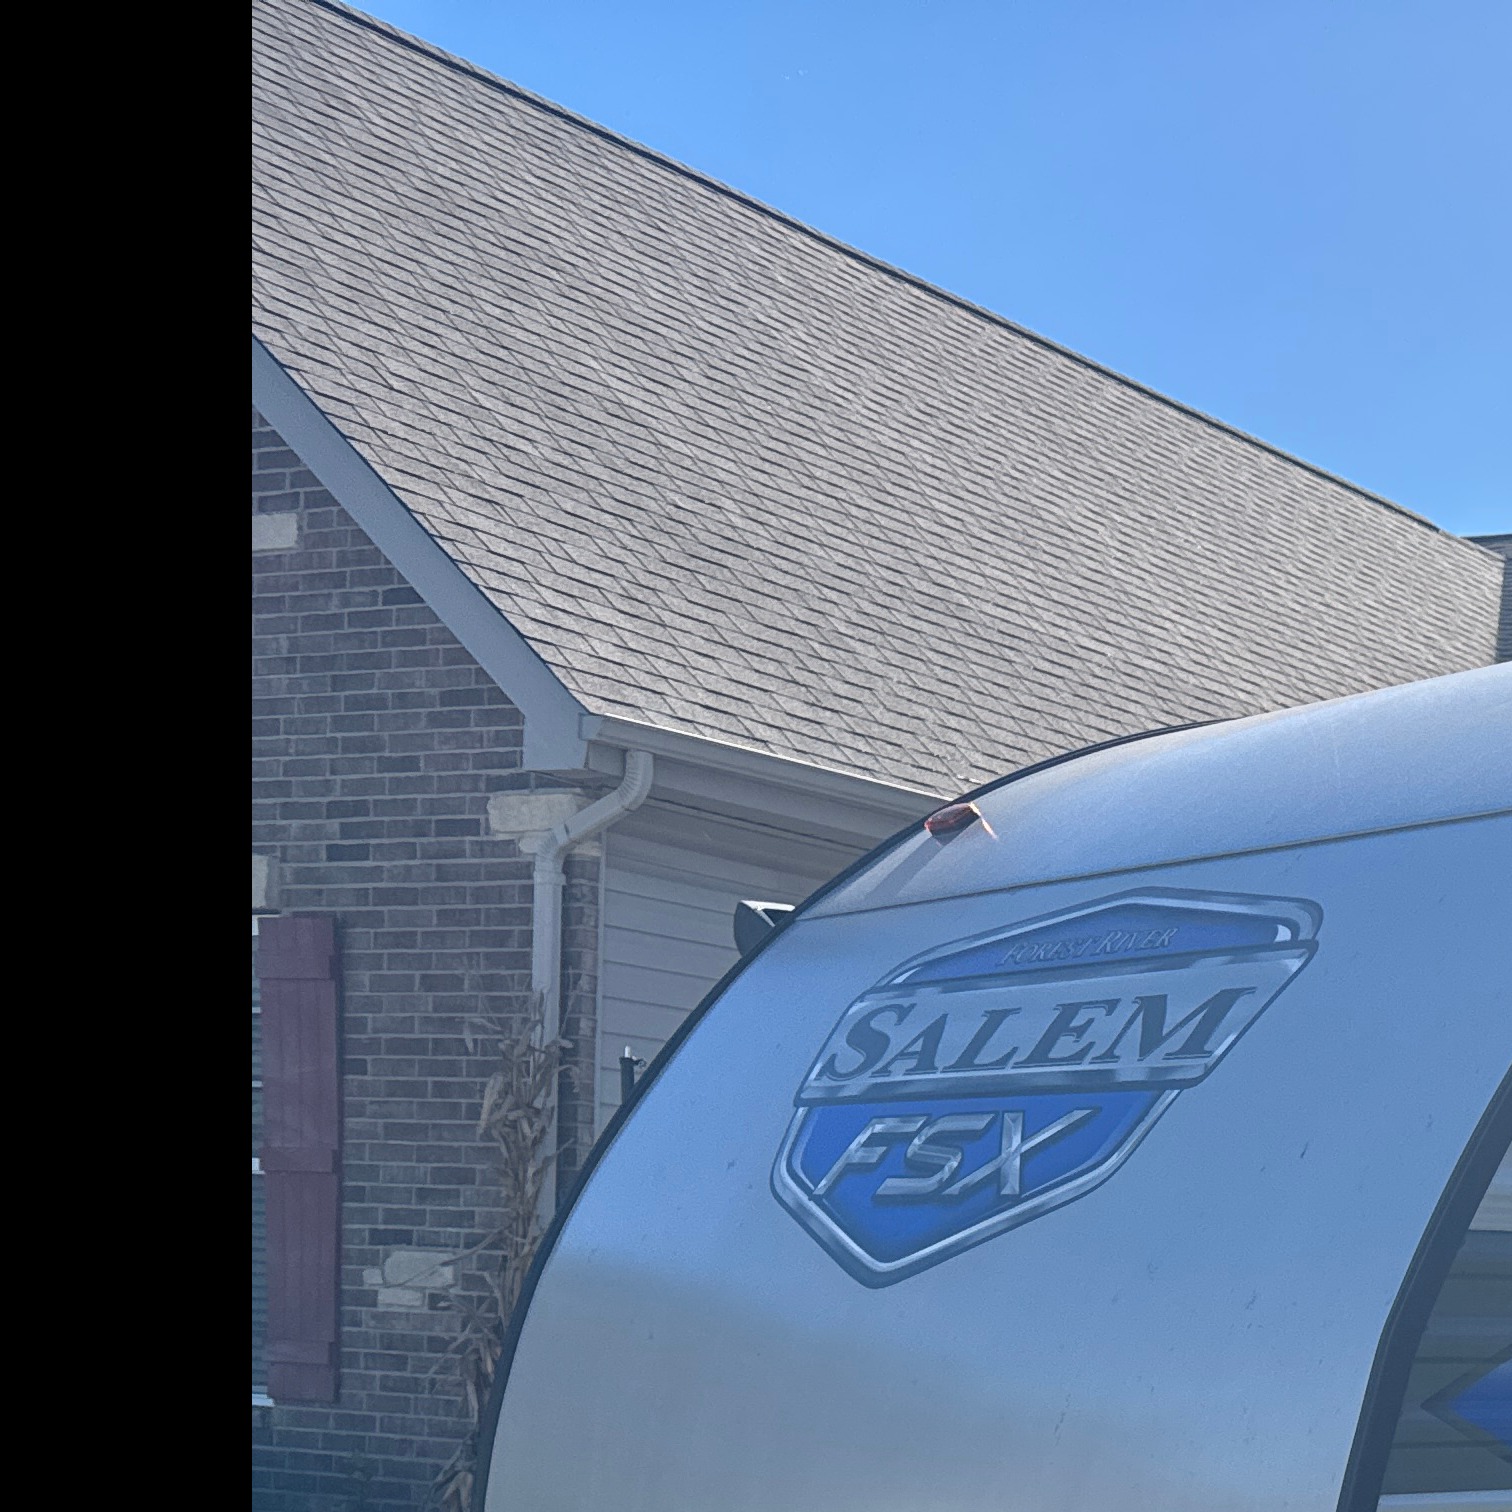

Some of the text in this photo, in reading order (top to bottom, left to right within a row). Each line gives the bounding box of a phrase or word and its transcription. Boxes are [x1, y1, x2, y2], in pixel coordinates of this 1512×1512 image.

[996, 928, 1178, 967] FOREST RIVER
[816, 986, 1258, 1082] SALEM
[810, 1108, 1100, 1200] FSX
